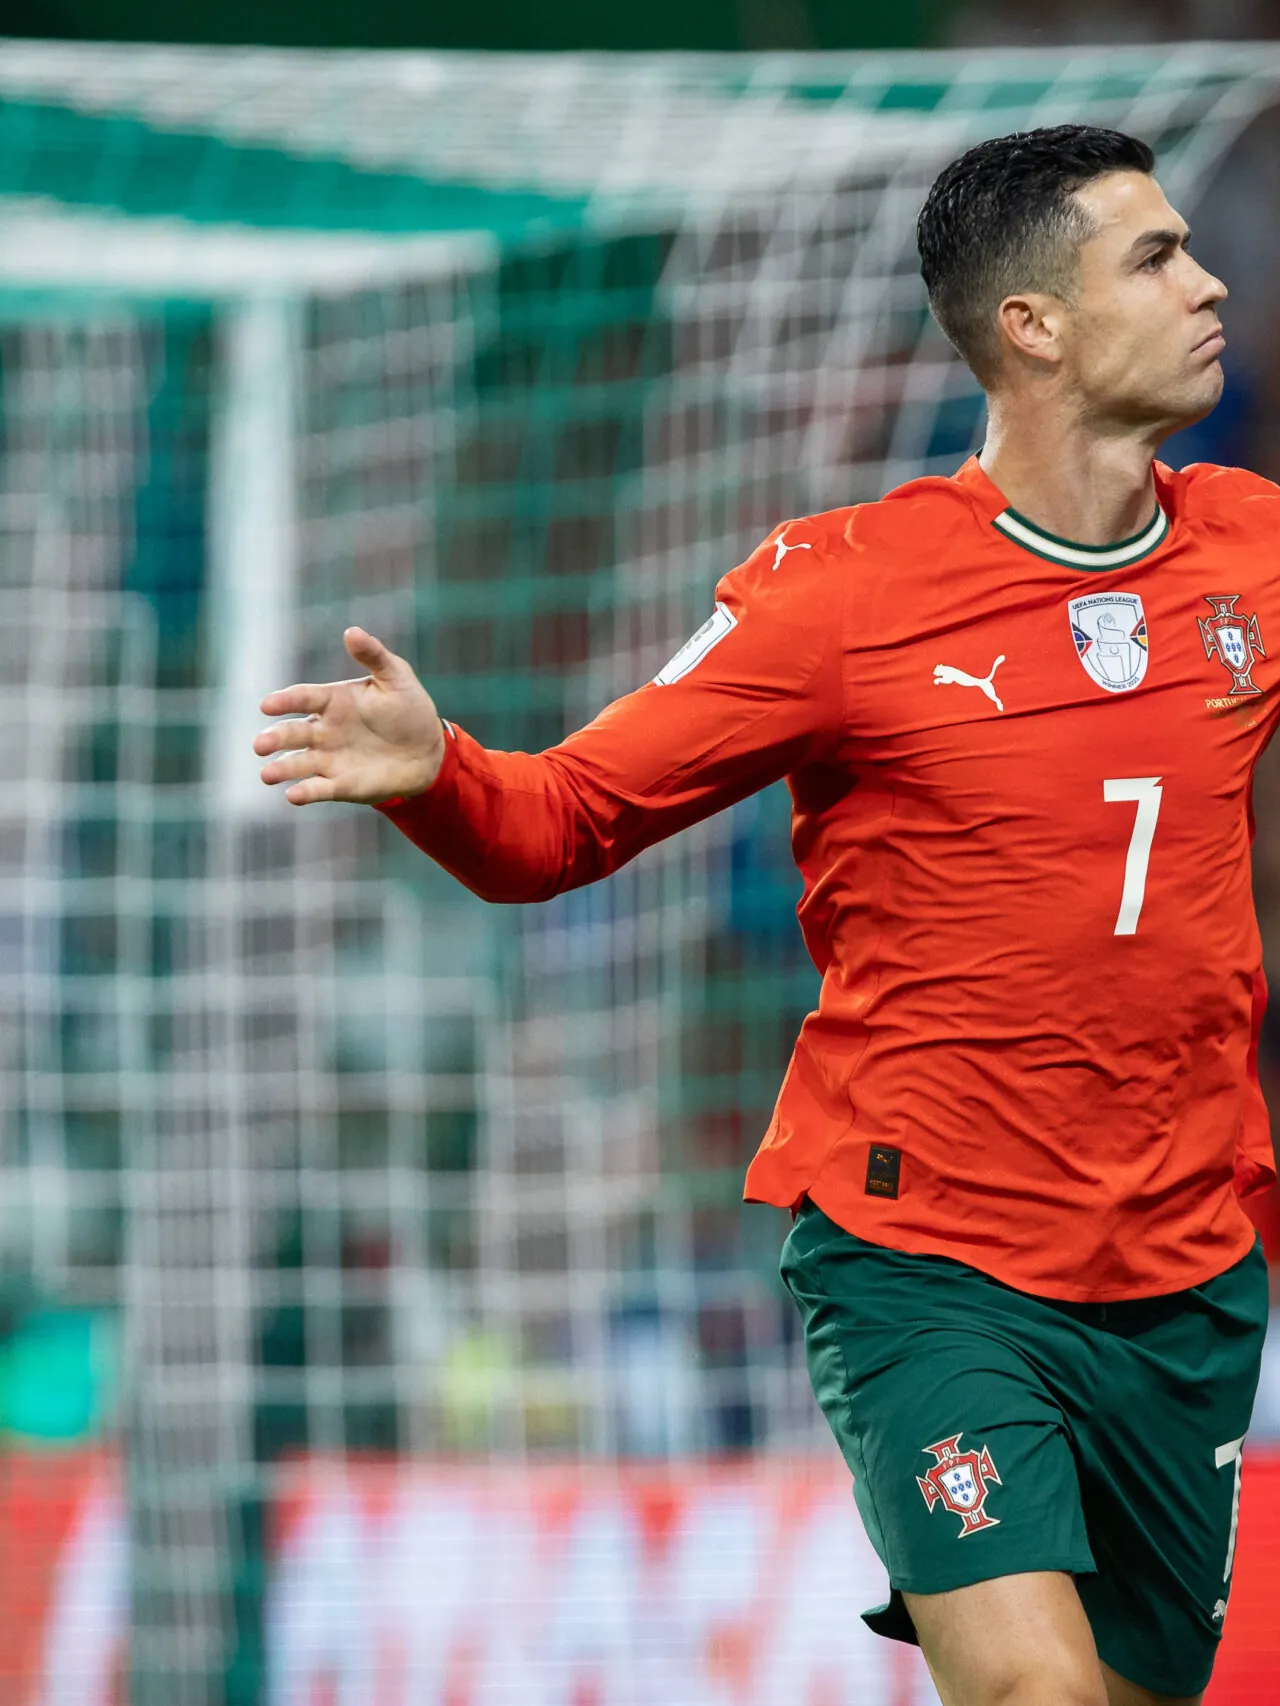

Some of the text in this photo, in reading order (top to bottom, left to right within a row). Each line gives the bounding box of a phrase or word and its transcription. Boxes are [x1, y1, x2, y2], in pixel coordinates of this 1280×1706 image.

[1072, 596, 1138, 610] UEFA NATIONS LEAGUE
[1101, 680, 1126, 689] WINNER
[1103, 776, 1163, 936] 7
[1215, 1436, 1246, 1583] 7
